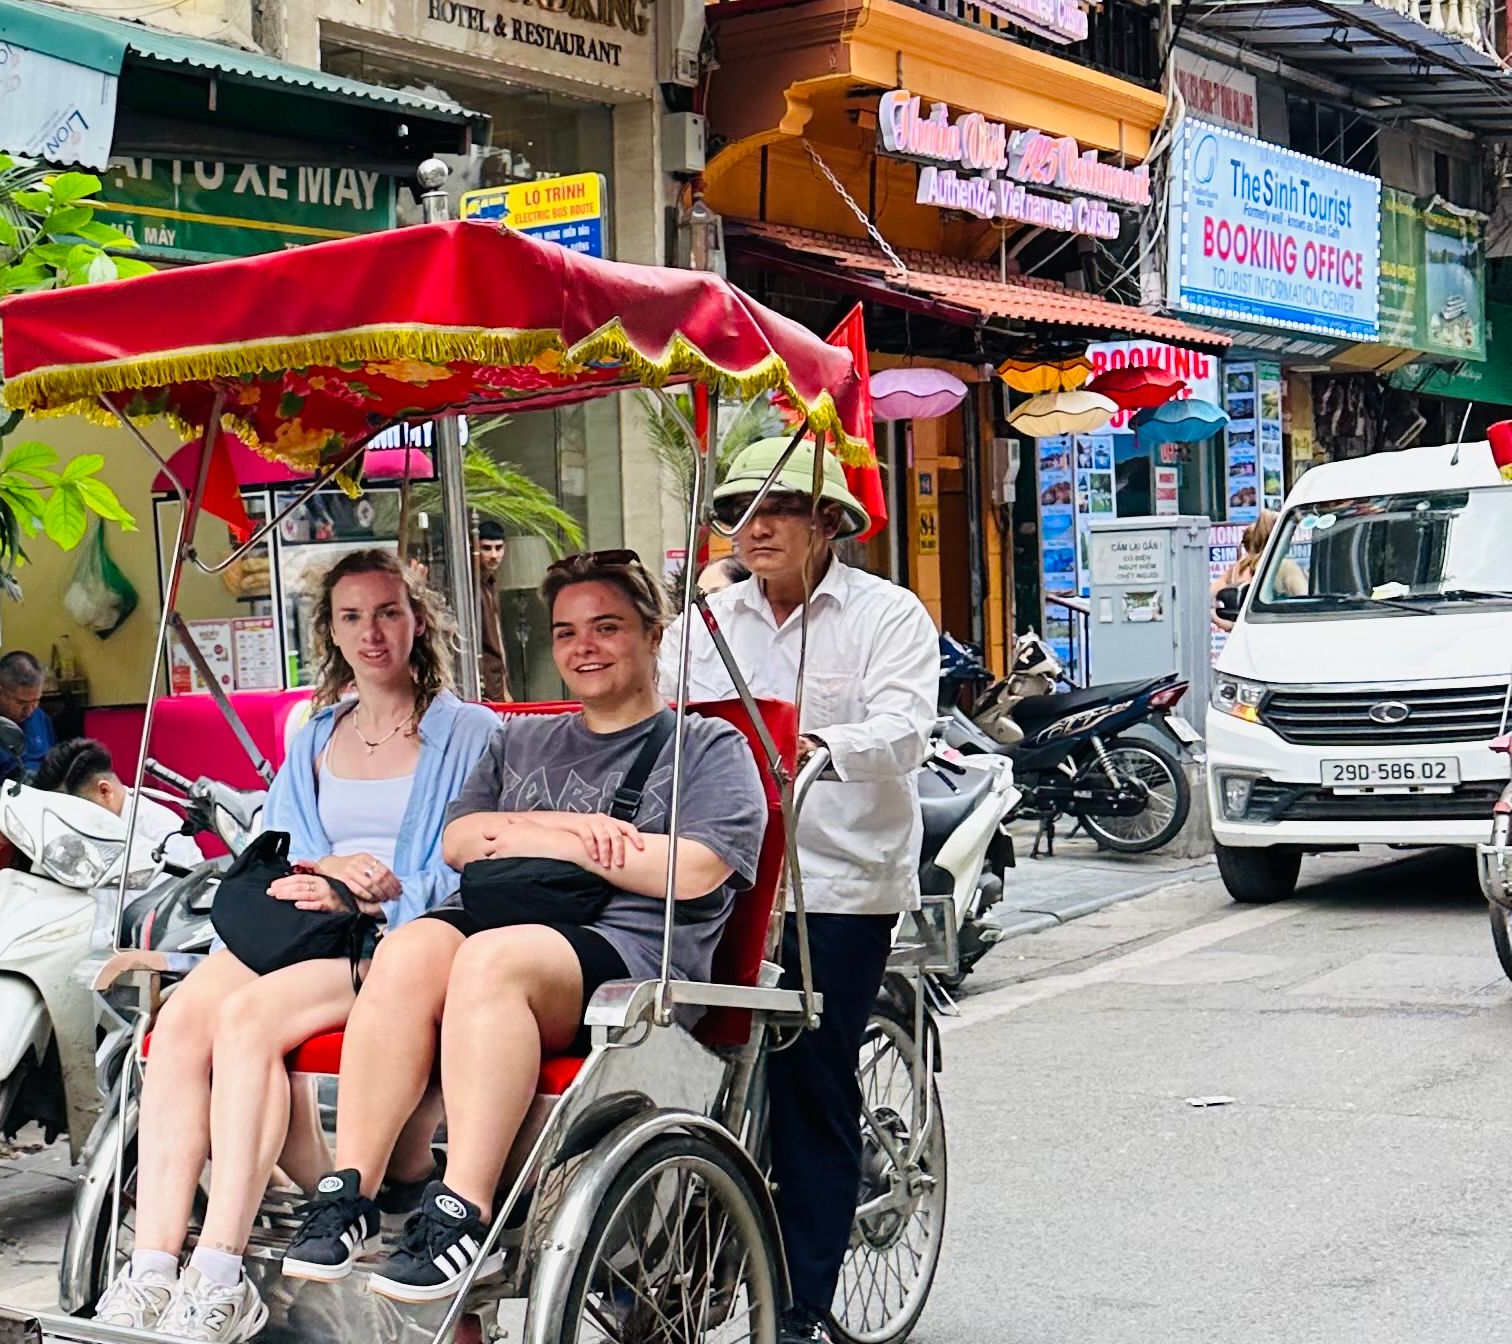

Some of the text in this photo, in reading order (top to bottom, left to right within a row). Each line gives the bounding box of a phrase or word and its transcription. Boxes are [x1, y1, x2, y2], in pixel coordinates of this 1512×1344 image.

[493, 12, 508, 38] &
[510, 17, 622, 67] RESTAURANT
[917, 166, 1121, 240] Authentic Vietnamese Cuisine
[1203, 215, 1364, 290] BOOKING OFFICE
[1212, 266, 1252, 298] TOURIST
[1254, 274, 1321, 310] INFORMATION
[1322, 289, 1355, 314] CENTER
[1212, 547, 1237, 561] SIM
[1332, 762, 1447, 782] 29D-586.02
